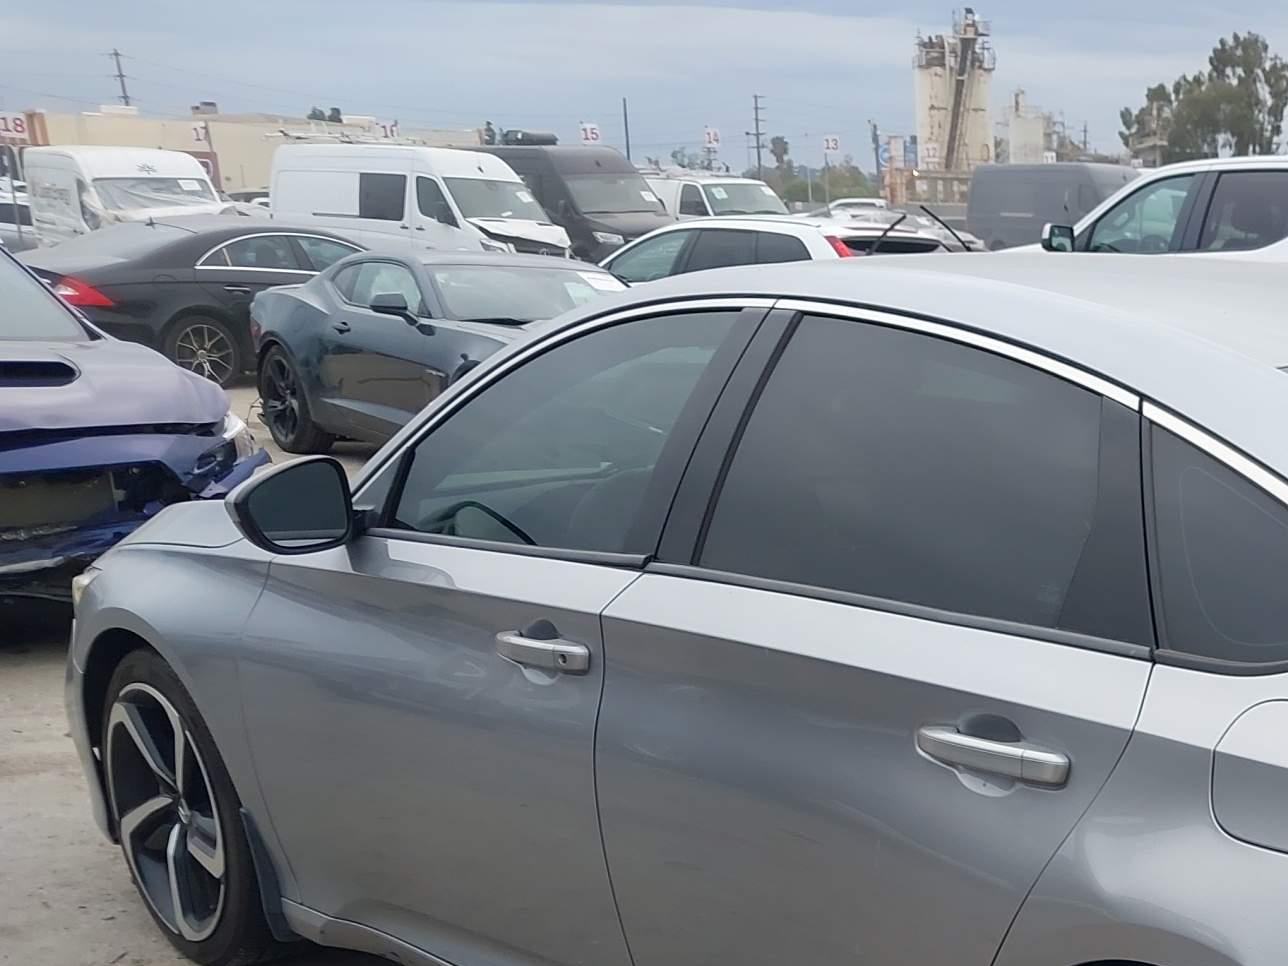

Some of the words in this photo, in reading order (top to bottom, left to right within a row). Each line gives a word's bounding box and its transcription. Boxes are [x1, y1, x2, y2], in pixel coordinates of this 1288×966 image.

[0, 117, 25, 133] 18
[581, 127, 600, 141] 15
[706, 131, 720, 144] 14
[824, 138, 839, 151] 13
